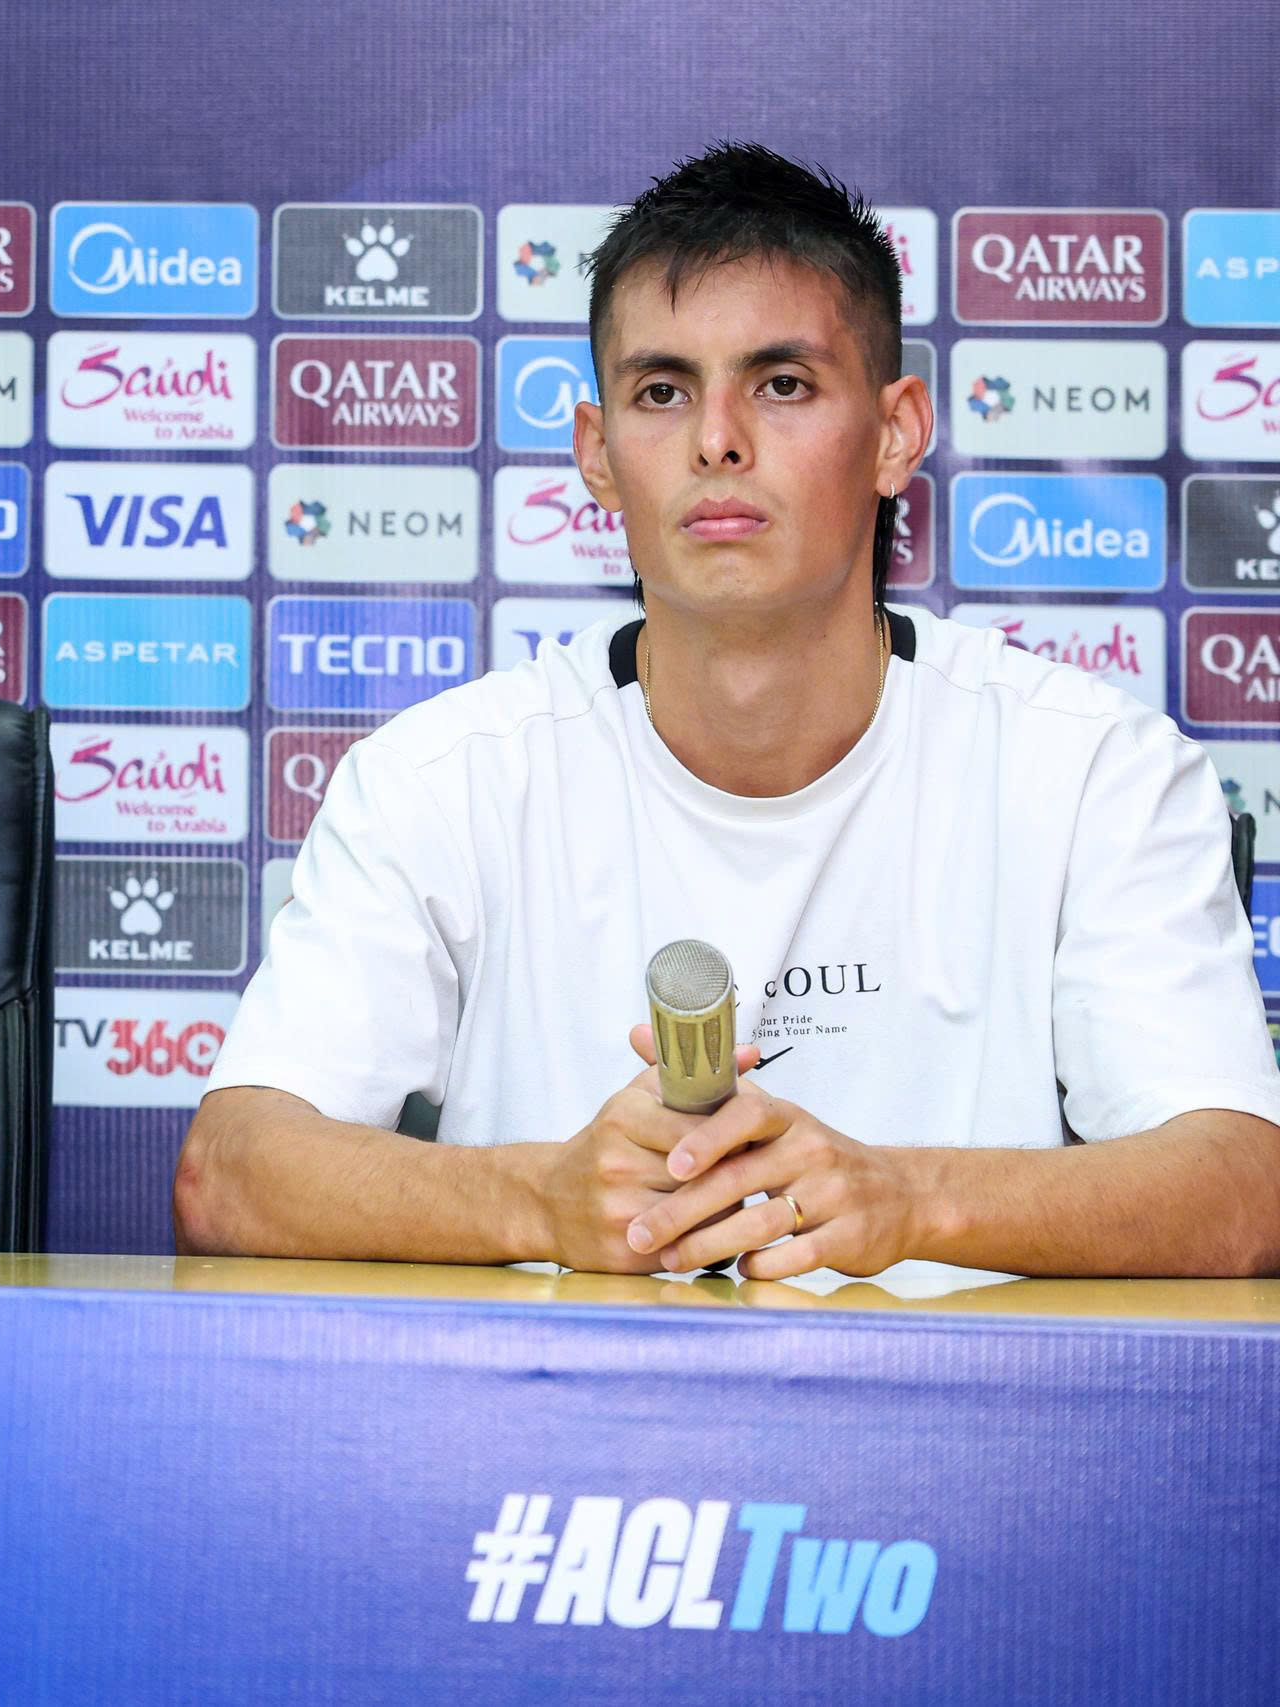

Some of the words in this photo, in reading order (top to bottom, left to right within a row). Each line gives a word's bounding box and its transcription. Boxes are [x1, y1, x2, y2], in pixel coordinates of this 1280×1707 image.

[972, 234, 1145, 283] QATAR
[325, 286, 430, 307] KELME
[1015, 278, 1147, 303] AIRWAYS
[290, 360, 459, 403] QATAR
[1034, 387, 1151, 413] NEOM
[123, 409, 204, 424] Welcome
[332, 402, 460, 428] AIRWAYS
[154, 426, 172, 440] to
[176, 425, 234, 440] Arabia
[66, 494, 228, 548] VISA
[349, 512, 463, 537] NEOM
[56, 642, 238, 668] ASPETAR
[278, 634, 465, 677] TECNO
[115, 801, 197, 816] Welcome
[147, 819, 164, 834] to
[169, 818, 227, 834] Arabia
[89, 939, 193, 962] KELME
[782, 1015, 813, 1025] Pride
[785, 1026, 811, 1036] Your
[816, 1025, 848, 1034] Name
